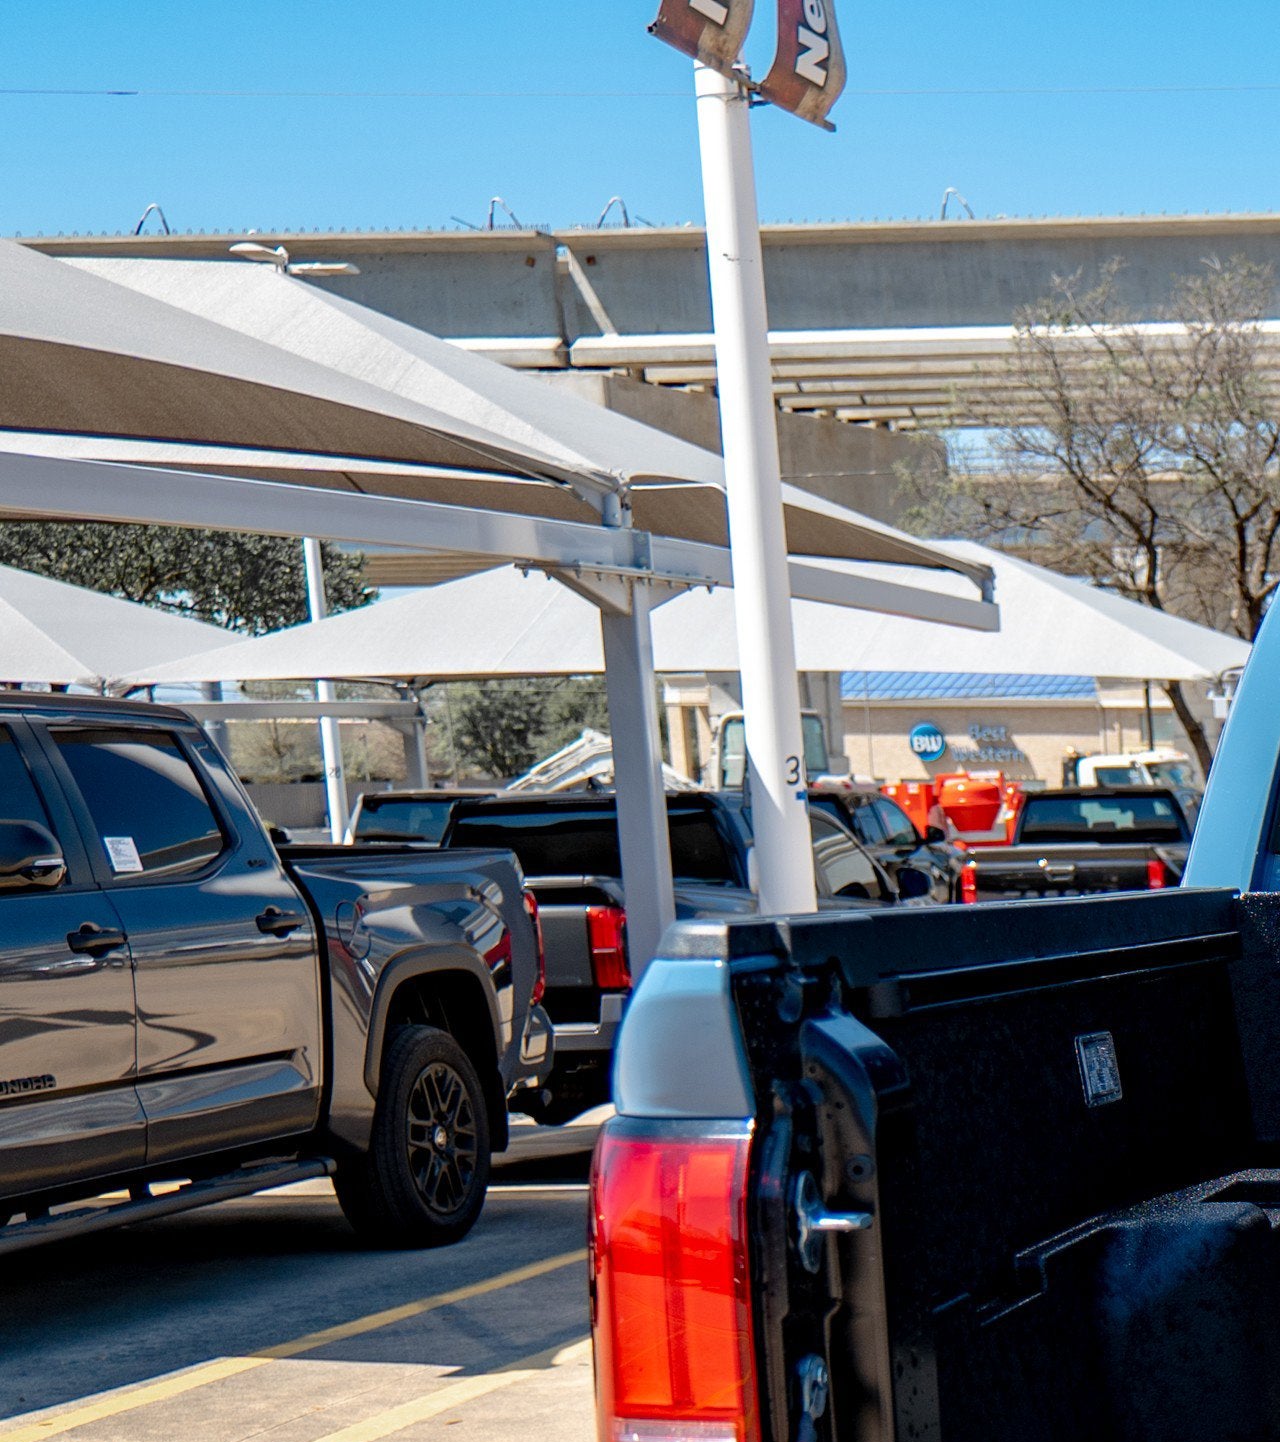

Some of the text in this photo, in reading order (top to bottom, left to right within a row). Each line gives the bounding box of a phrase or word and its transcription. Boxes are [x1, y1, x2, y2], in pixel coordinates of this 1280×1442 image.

[967, 724, 1007, 742] Best
[912, 735, 942, 752] BW
[950, 745, 1025, 763] Western
